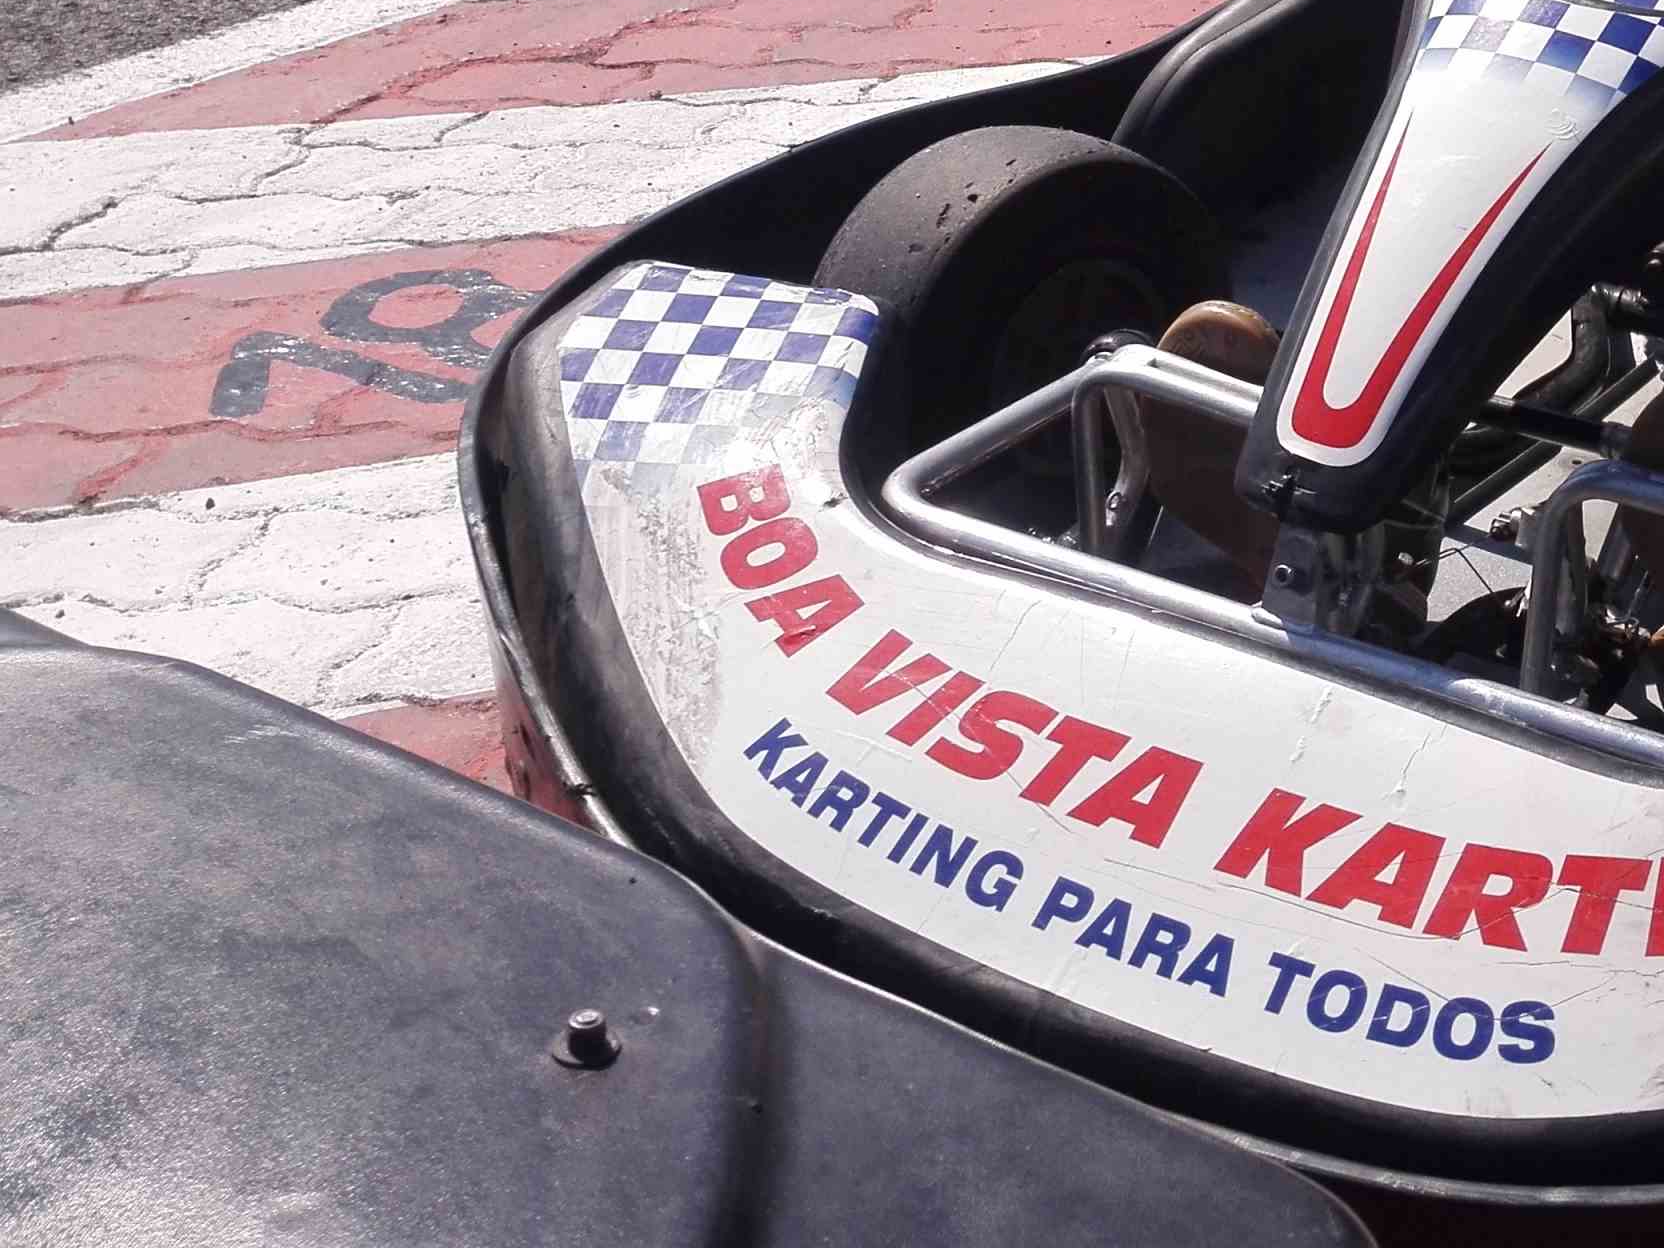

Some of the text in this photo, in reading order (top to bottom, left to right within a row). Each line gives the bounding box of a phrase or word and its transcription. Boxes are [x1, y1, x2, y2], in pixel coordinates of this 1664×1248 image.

[696, 463, 865, 658] BOA
[825, 628, 1205, 849] VISTA
[742, 717, 1557, 1064] KARTING PARA TODOS
